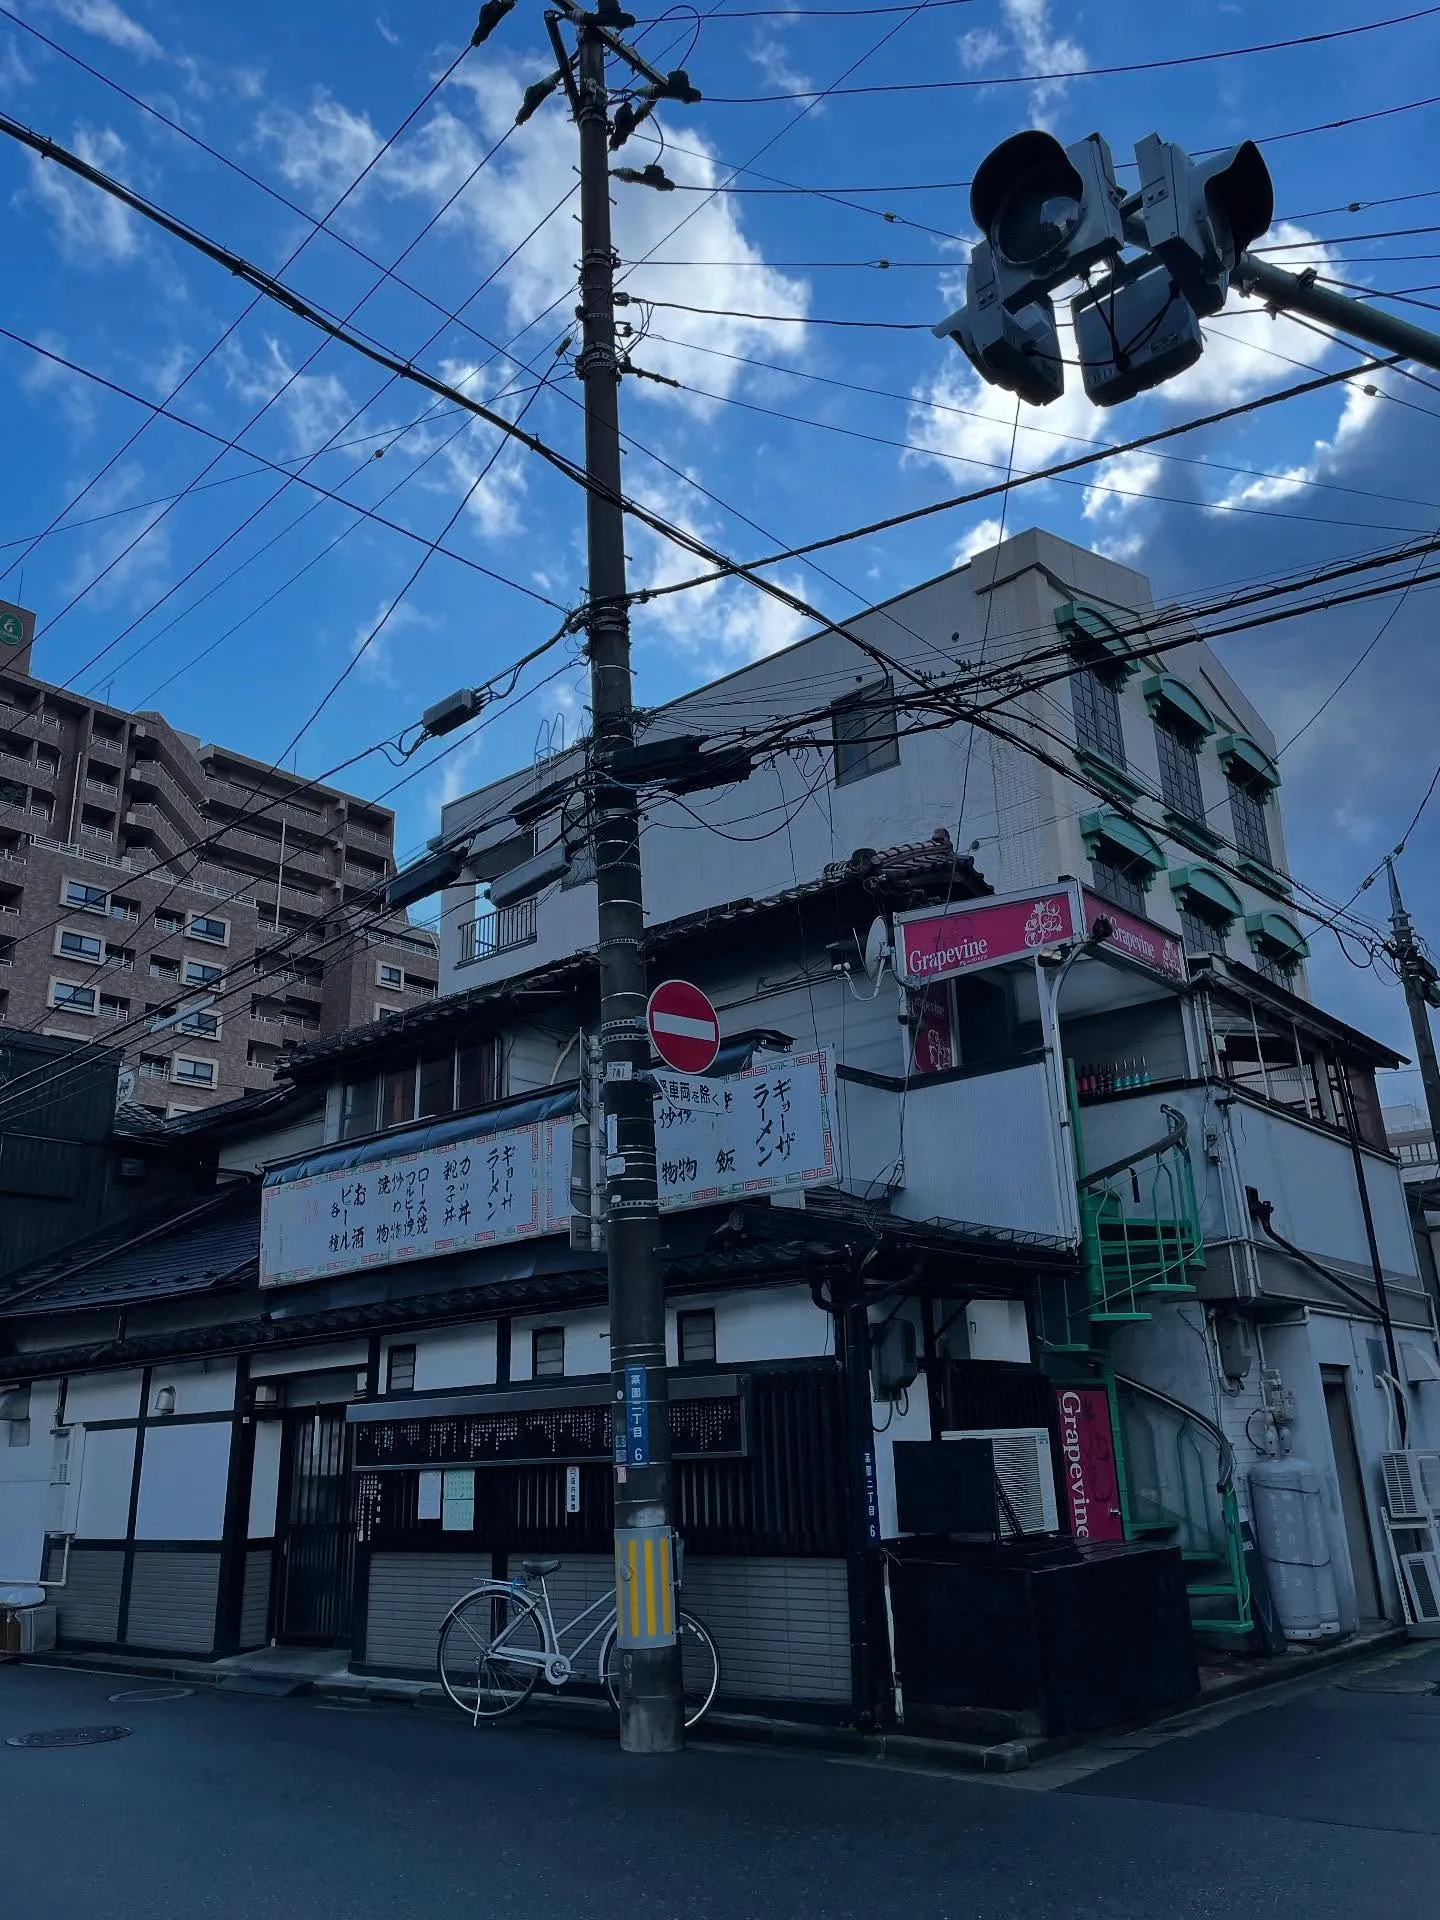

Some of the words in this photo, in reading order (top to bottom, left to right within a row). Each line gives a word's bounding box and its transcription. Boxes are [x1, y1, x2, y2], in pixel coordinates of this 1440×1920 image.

[909, 938, 988, 974] Grapevine
[1110, 916, 1155, 958] Grapevine
[752, 1083, 770, 1168] ラーメン
[339, 1183, 354, 1251] ビール
[442, 1159, 458, 1228] 親子丼
[457, 1154, 472, 1226] カツ丼
[486, 1147, 500, 1222] ラーメン
[634, 1448, 643, 1461] 6
[1061, 1391, 1090, 1539] Grapevine
[869, 1525, 876, 1538] 6
